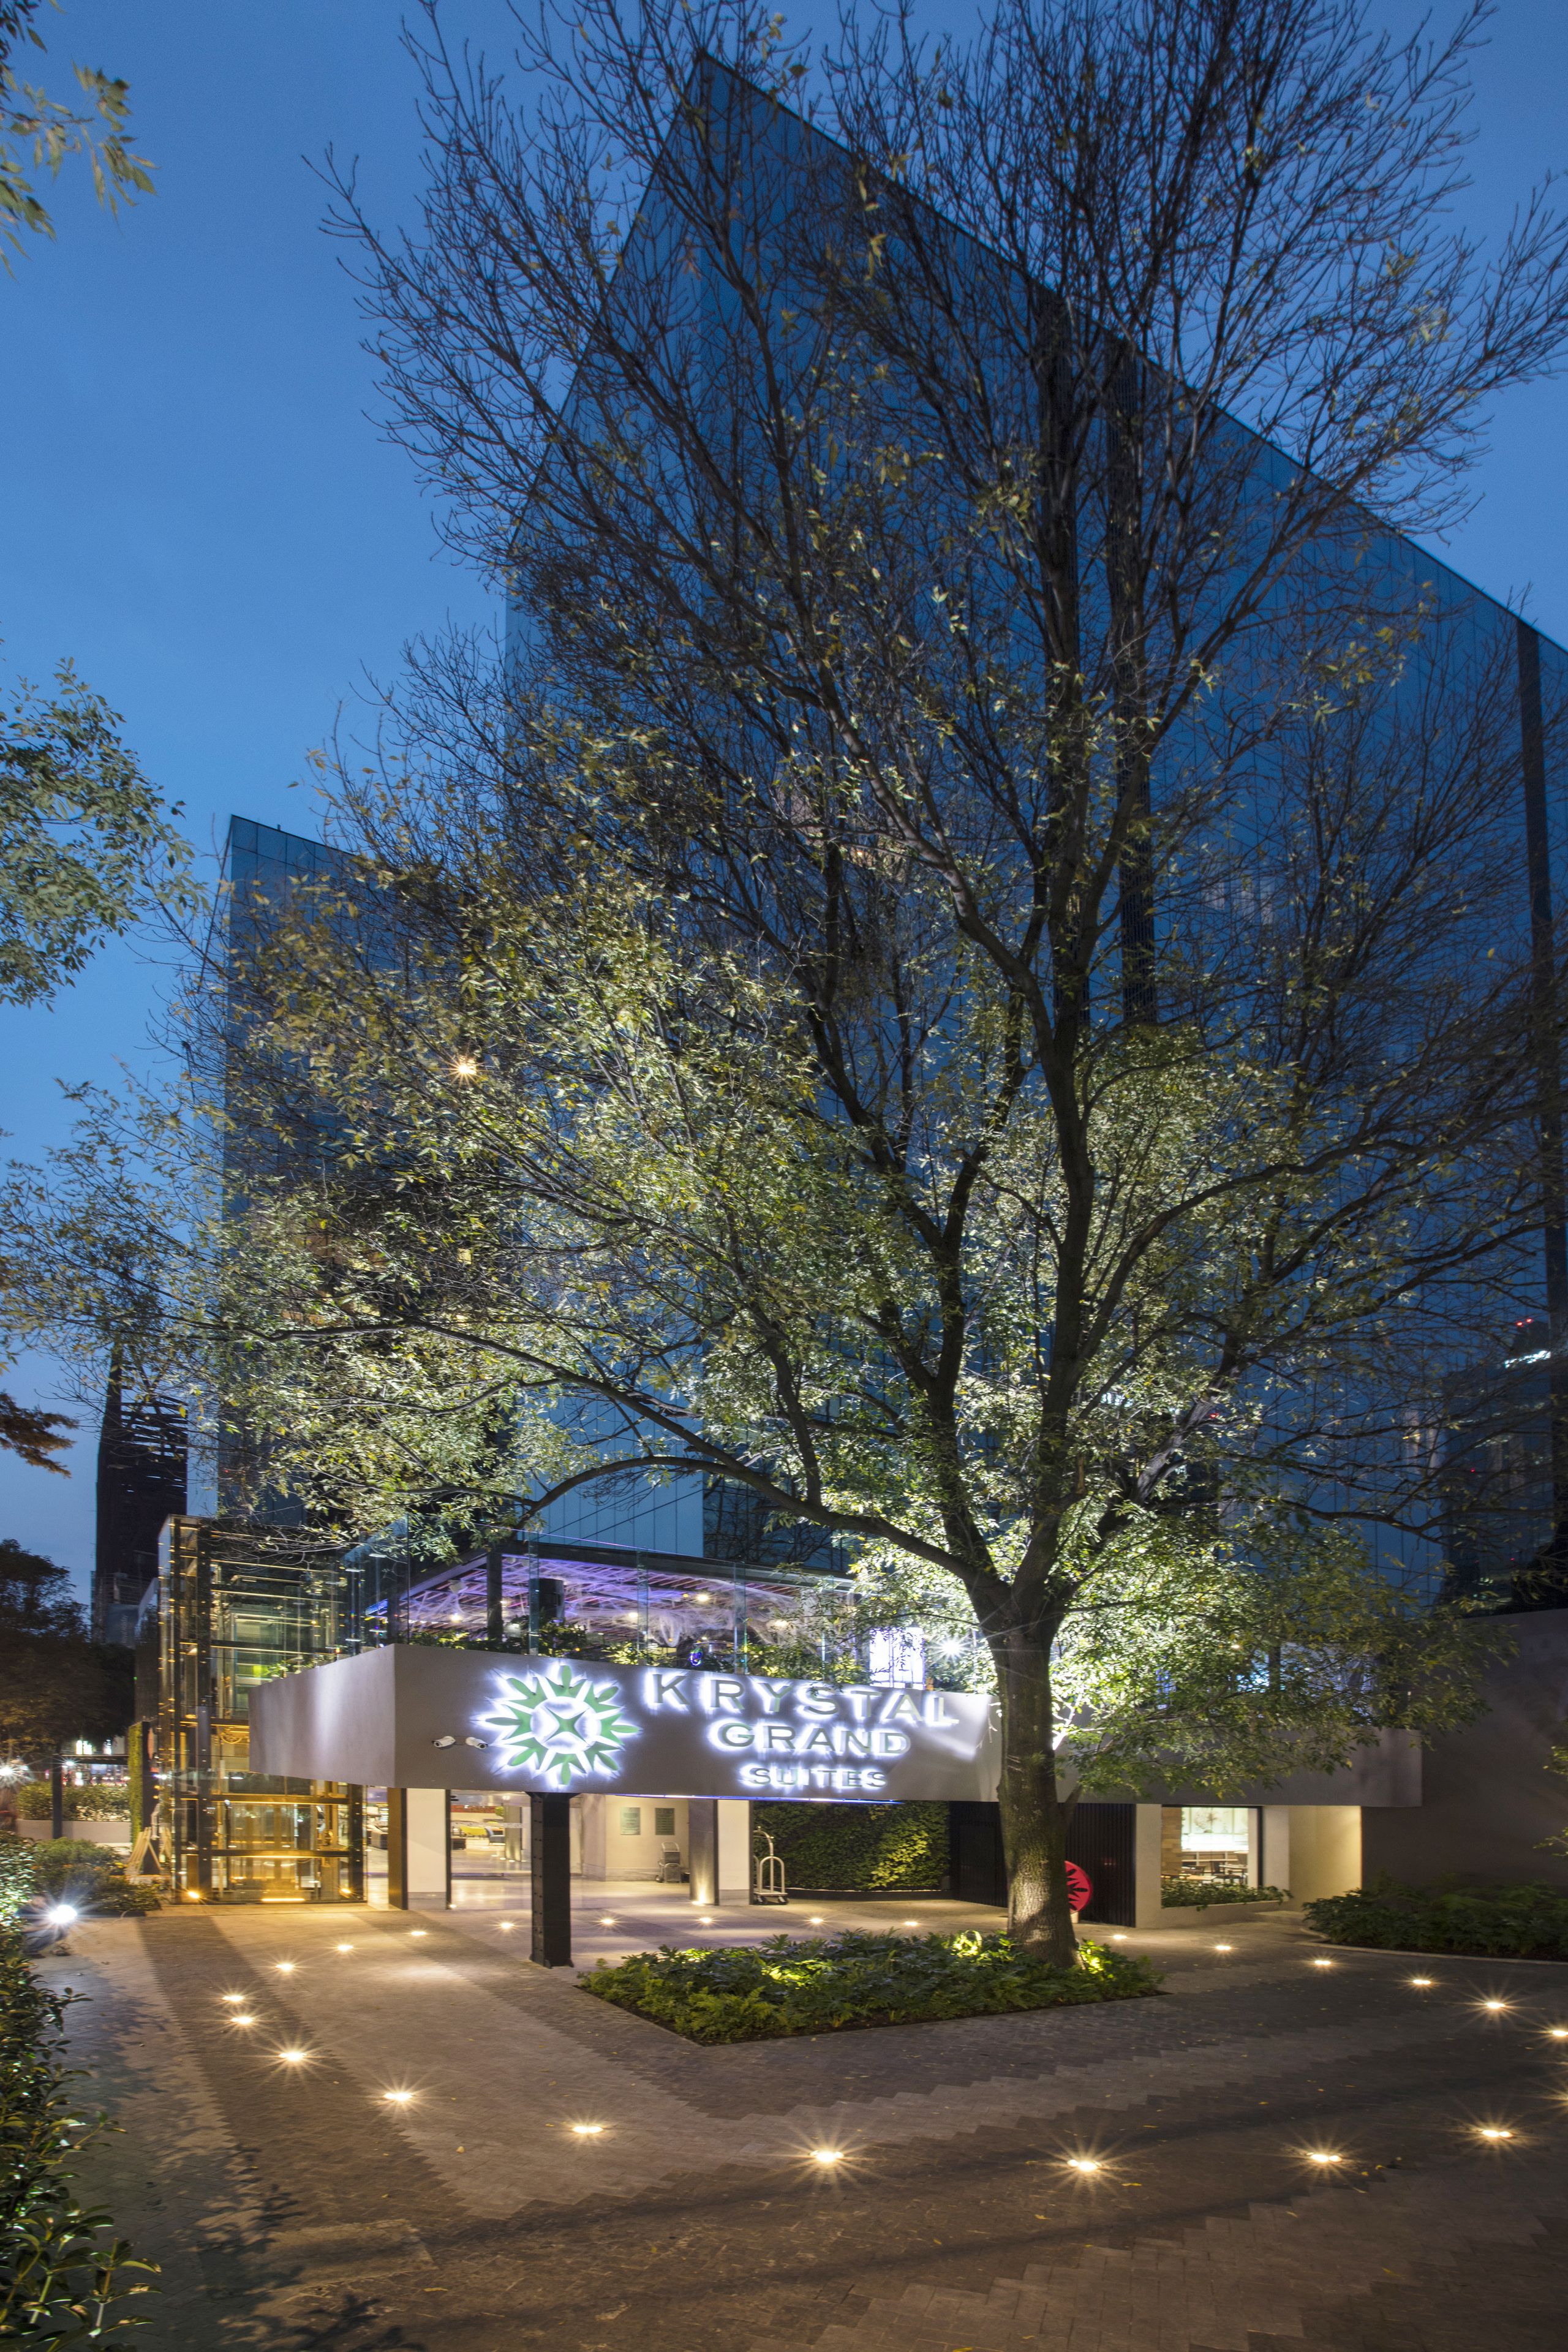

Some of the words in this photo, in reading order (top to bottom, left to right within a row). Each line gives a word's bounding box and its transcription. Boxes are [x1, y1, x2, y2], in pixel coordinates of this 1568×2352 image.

[651, 1673, 960, 1725] KRYSTAL
[717, 1722, 911, 1754] GRAND
[748, 1766, 888, 1788] SUITES
